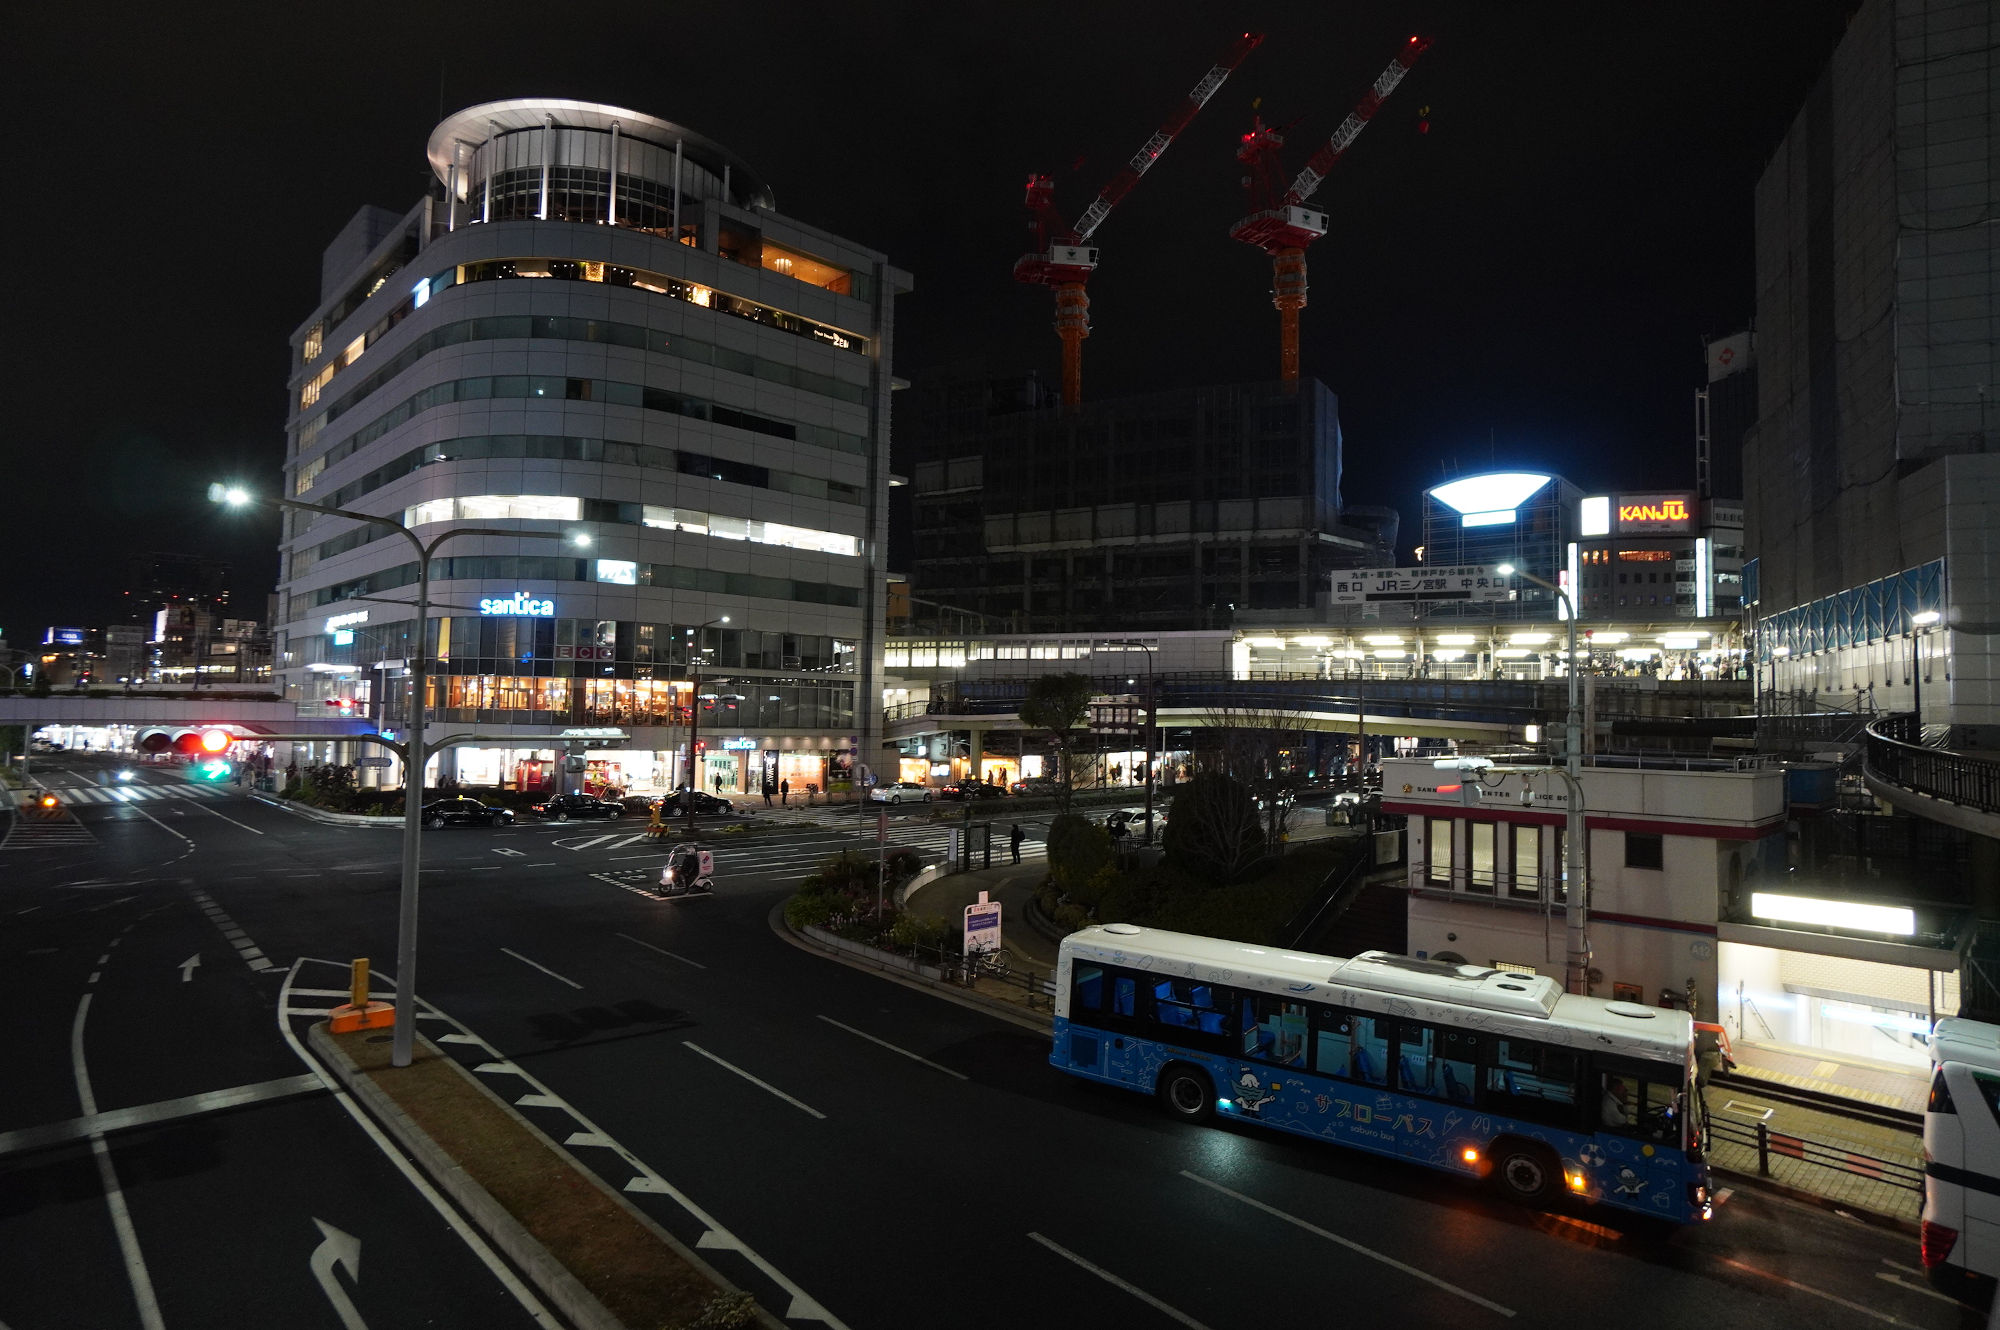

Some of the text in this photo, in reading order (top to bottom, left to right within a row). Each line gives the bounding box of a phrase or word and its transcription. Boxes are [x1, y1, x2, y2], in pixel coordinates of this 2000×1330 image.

[1337, 577, 1505, 592] 西口 JR三ノ宮駅 中央口
[480, 591, 554, 616] santica
[1482, 790, 1511, 798] ENTER
[1350, 1125, 1395, 1142] saburo bus
